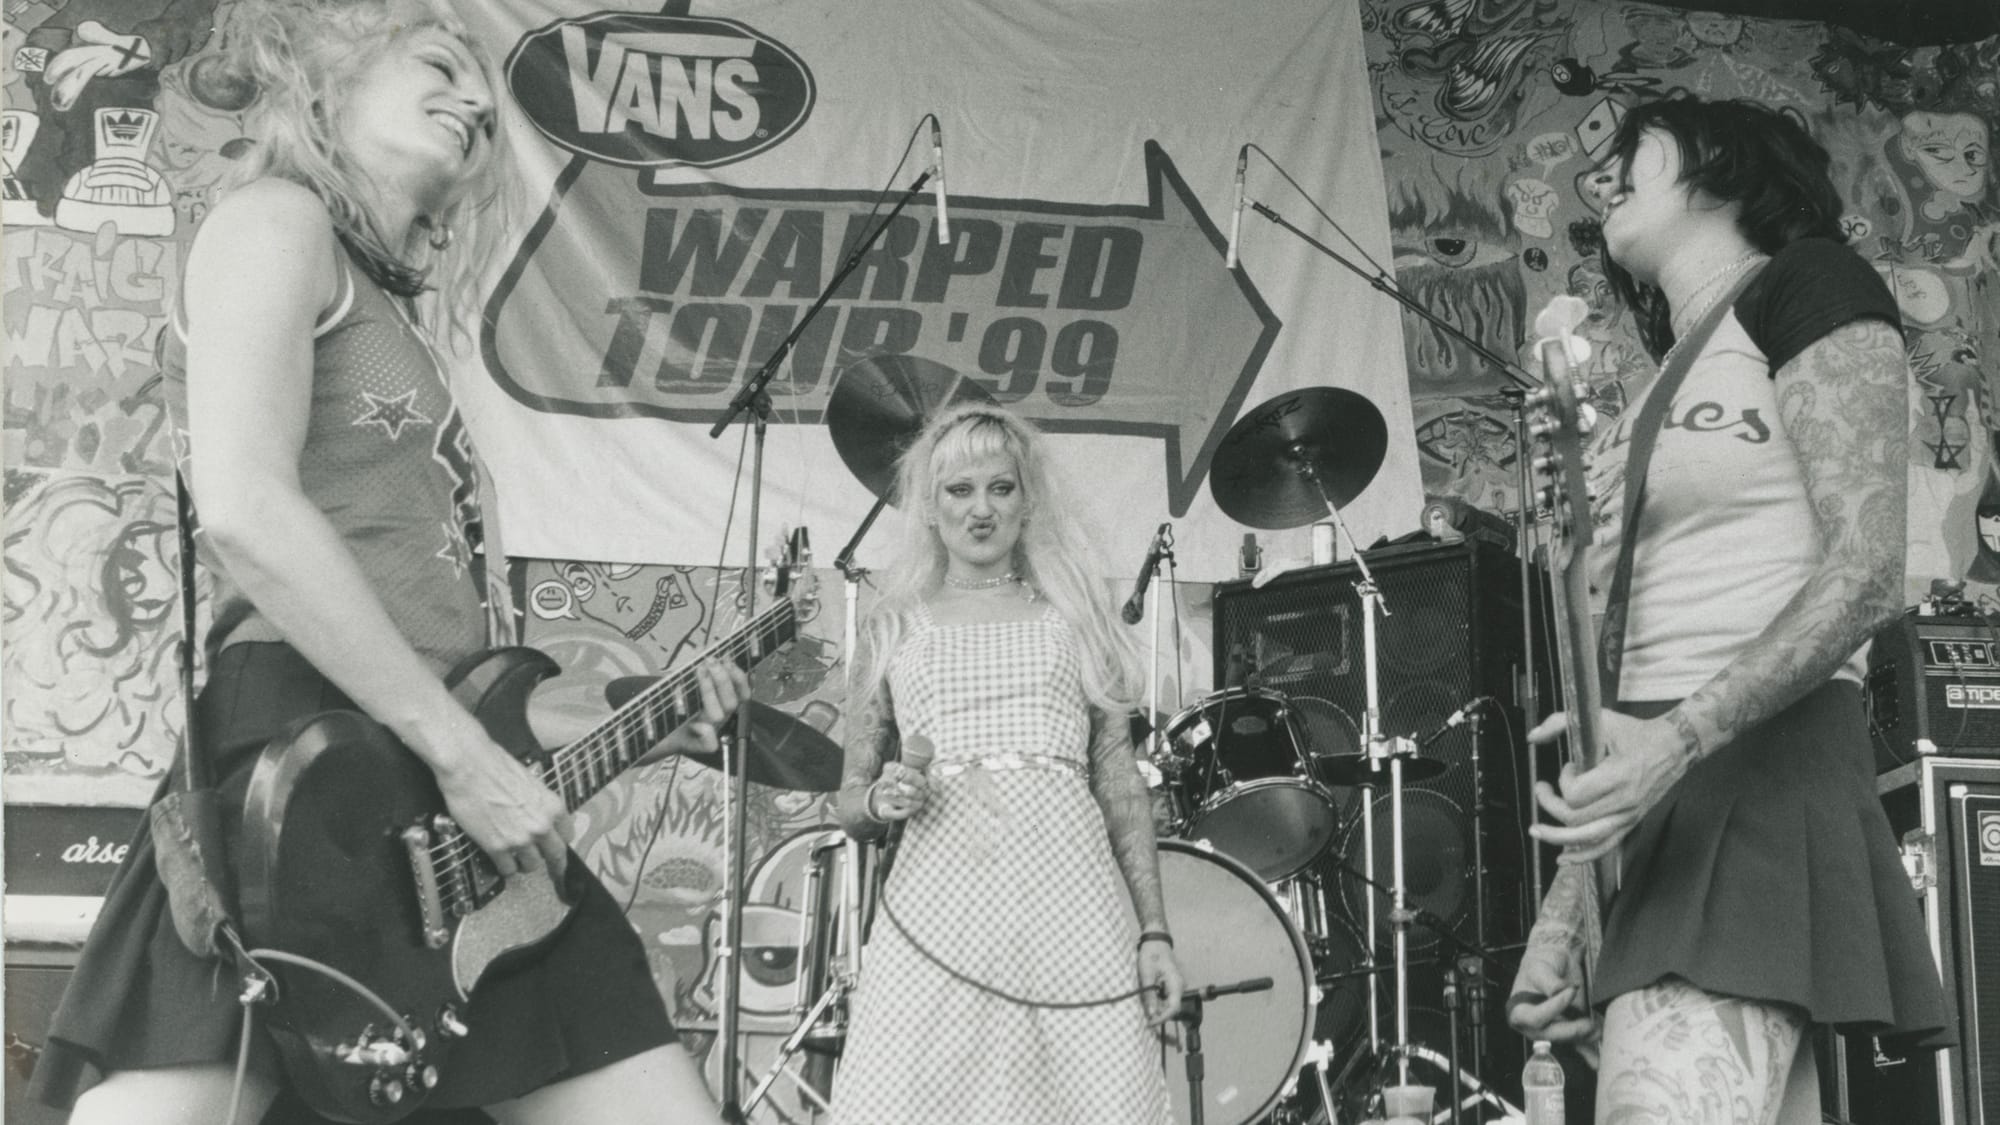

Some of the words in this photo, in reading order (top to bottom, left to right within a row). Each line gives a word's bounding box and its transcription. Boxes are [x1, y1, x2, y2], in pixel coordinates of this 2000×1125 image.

[561, 24, 761, 142] VANS
[639, 207, 1144, 310] WARPED
[596, 296, 922, 395] TOUR
[947, 313, 1119, 407] '99
